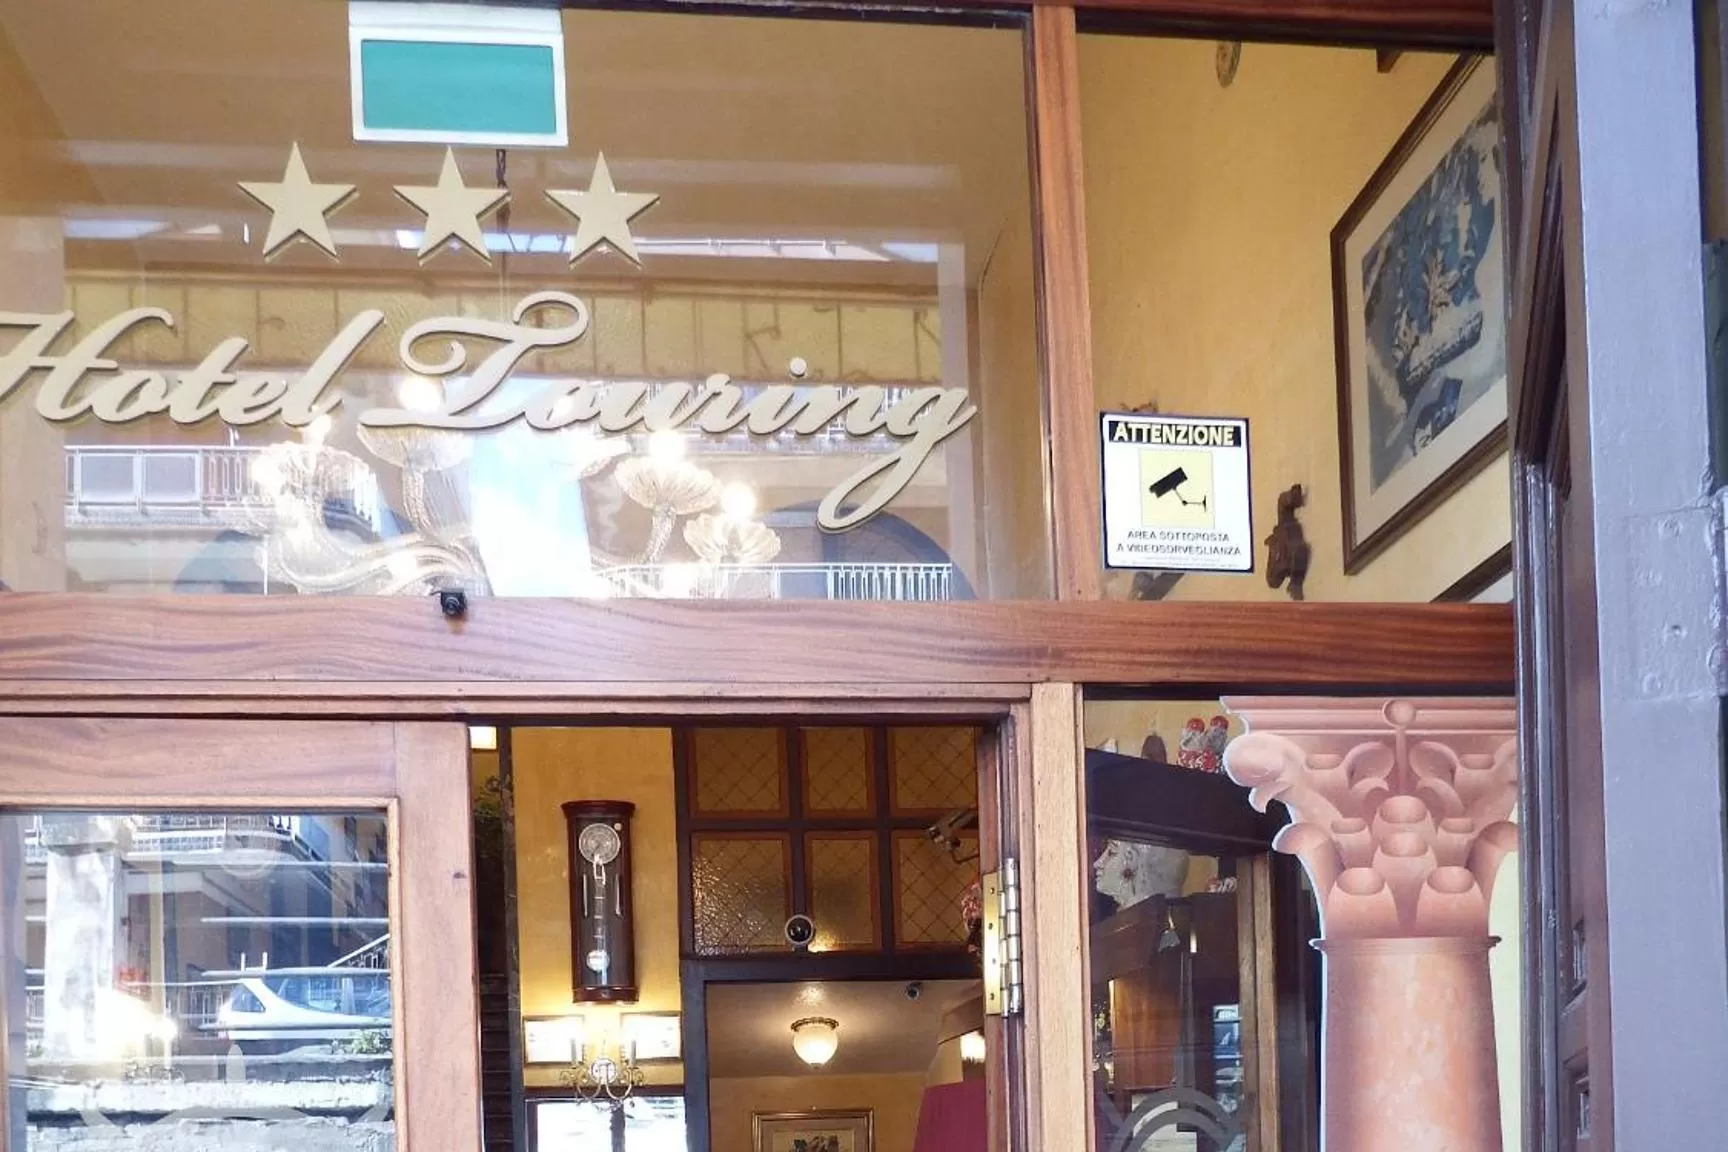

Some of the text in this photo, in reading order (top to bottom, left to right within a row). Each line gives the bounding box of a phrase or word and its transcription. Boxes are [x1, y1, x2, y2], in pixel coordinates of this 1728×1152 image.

[0, 291, 978, 533] Hotel Touring
[1113, 422, 1234, 446] ATTENZIONE
[1127, 531, 1230, 543] AREA SOTTOPOSTA
[1116, 543, 1242, 556] A VIDEOSORVEGLIANZA
